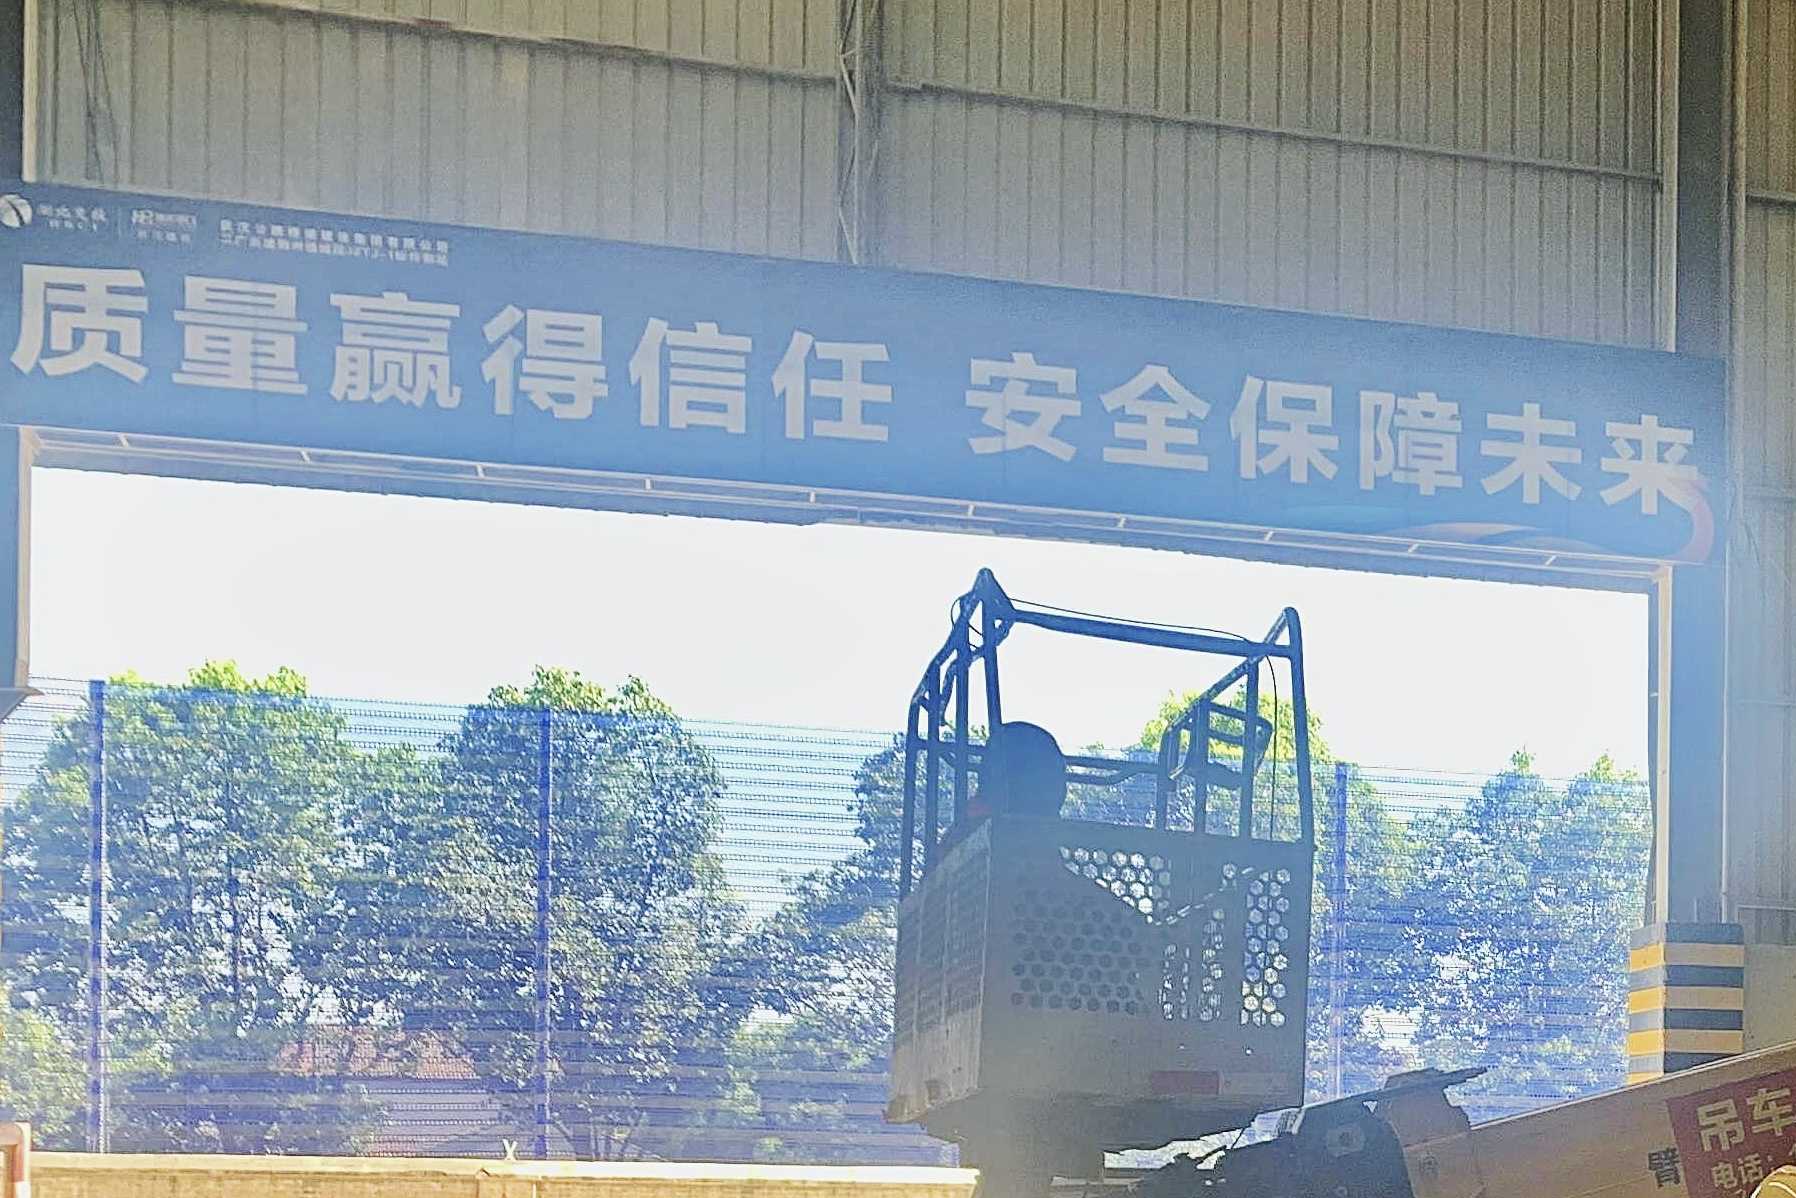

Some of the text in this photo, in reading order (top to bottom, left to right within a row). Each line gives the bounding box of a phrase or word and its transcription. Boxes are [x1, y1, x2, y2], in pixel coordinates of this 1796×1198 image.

[10, 262, 1704, 516] 质量赢得信任 安全保障未来
